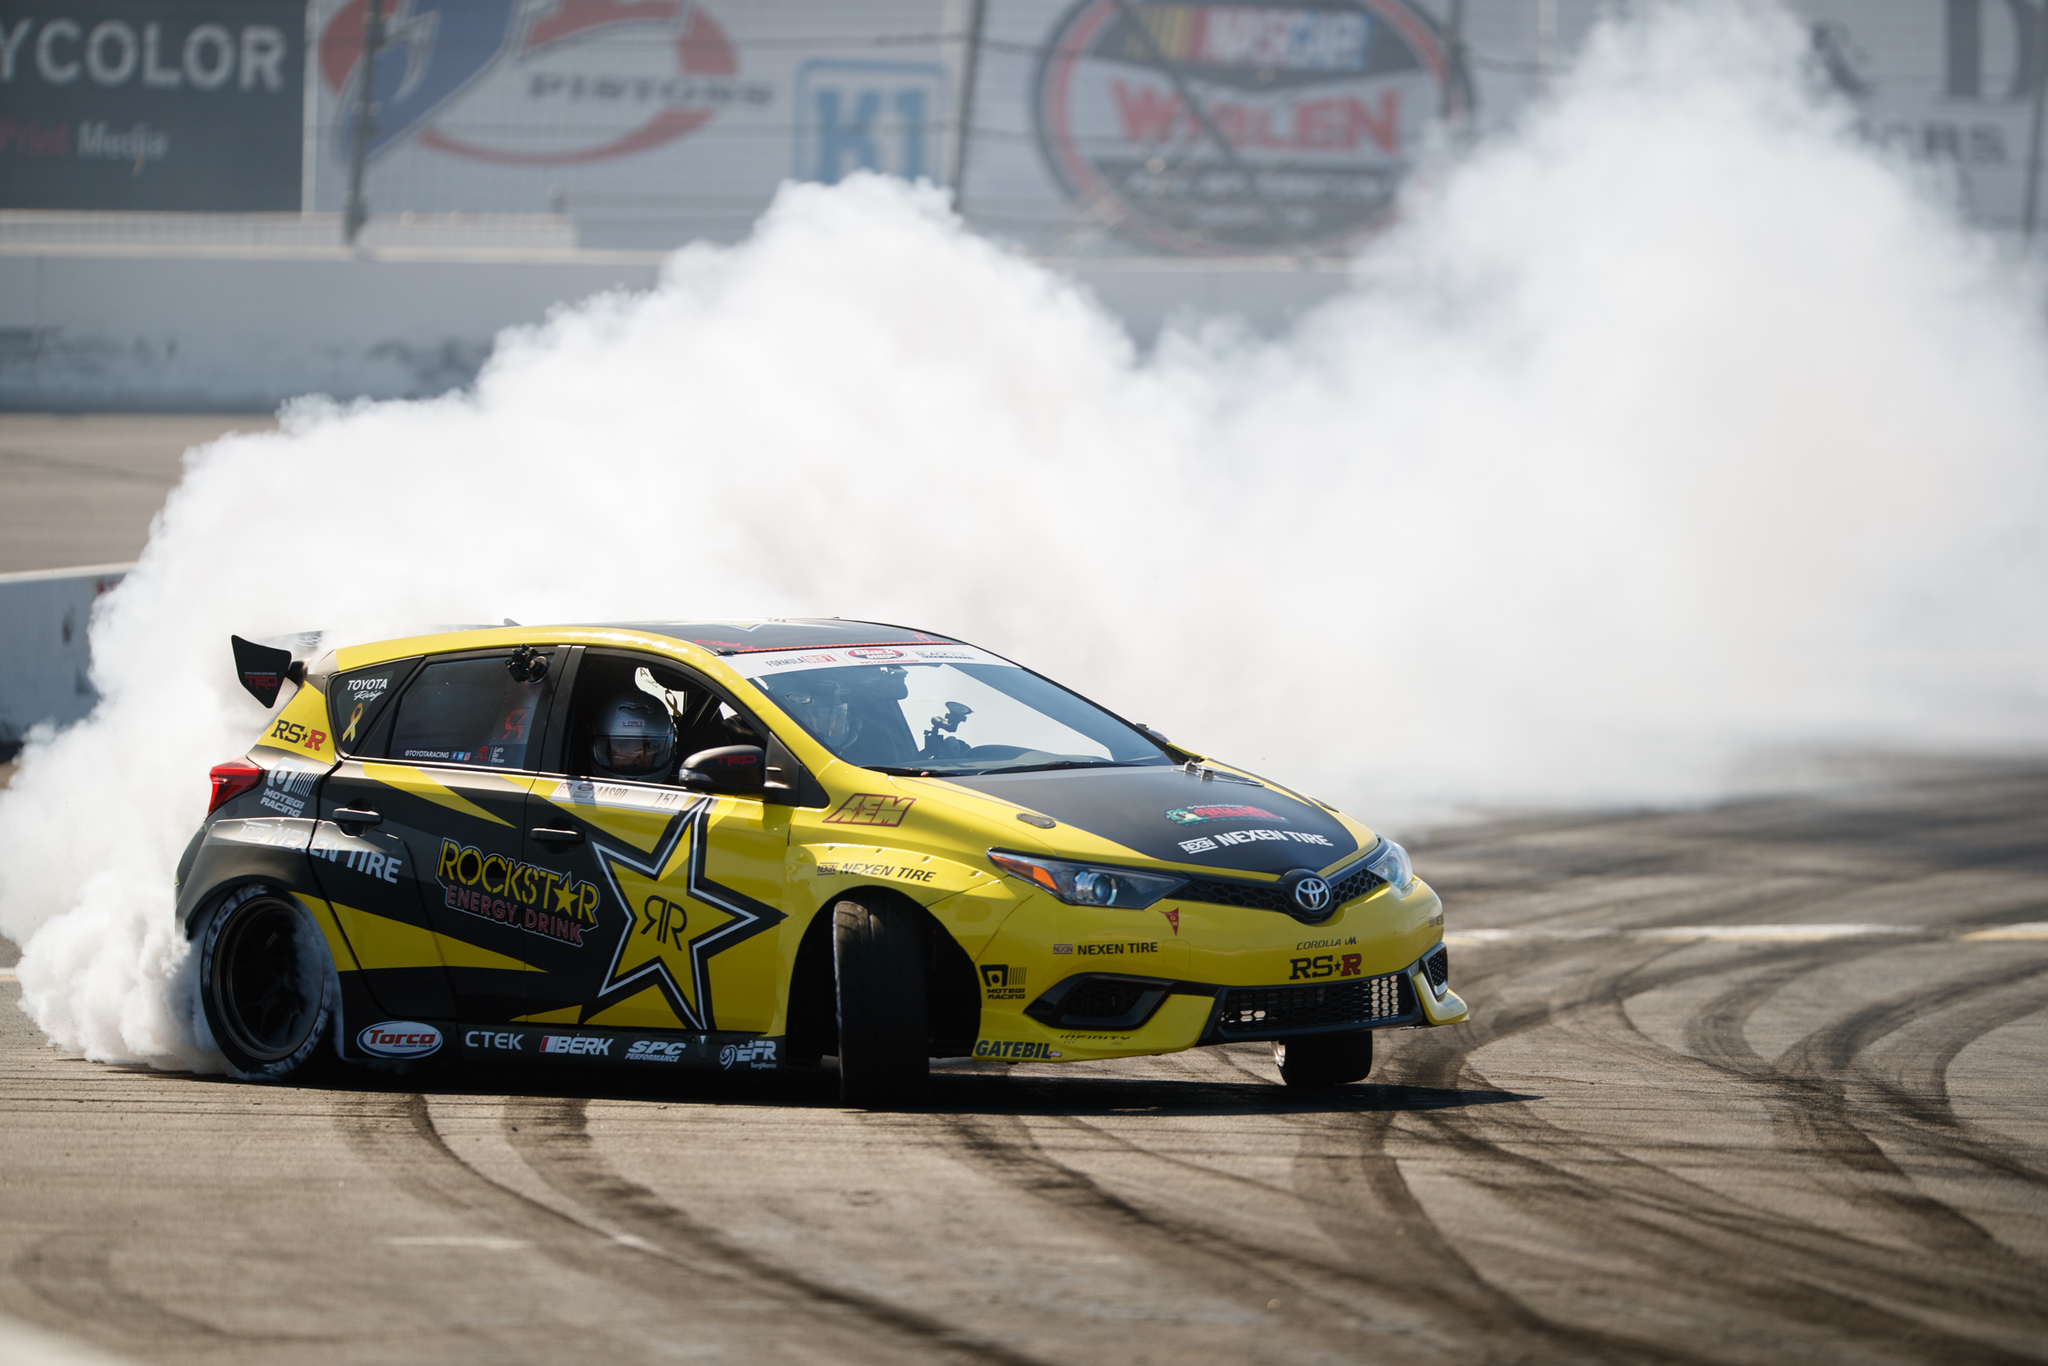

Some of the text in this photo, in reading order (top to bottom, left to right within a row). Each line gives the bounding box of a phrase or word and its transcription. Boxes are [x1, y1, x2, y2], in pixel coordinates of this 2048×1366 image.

[816, 88, 928, 185] K1
[244, 675, 278, 690] TRD
[347, 679, 388, 691] TOYOTA
[405, 750, 449, 759] @TOYOTARACING
[713, 755, 757, 767] TRD
[260, 797, 302, 818] RACING
[263, 788, 305, 809] MOTEGI
[822, 793, 918, 827] AEM
[1214, 829, 1289, 847] NEXEN
[1283, 831, 1334, 847] TIRE
[267, 826, 345, 862] NEXEN
[346, 844, 402, 884] TIRE
[840, 863, 895, 876] NEXEN
[897, 867, 937, 882] TIRE
[447, 885, 582, 943] ENERGY DRINK
[1077, 944, 1124, 956] NEXEN
[1127, 942, 1159, 953] TIRE
[1296, 938, 1342, 950] COROLLA
[369, 1029, 437, 1045] Torco
[465, 1031, 525, 1050] CTEK
[554, 1036, 615, 1056] BERK
[627, 1040, 687, 1055] SPC
[975, 1040, 1052, 1060] GATEBIL
[624, 1053, 680, 1062] PERFORMANCE
